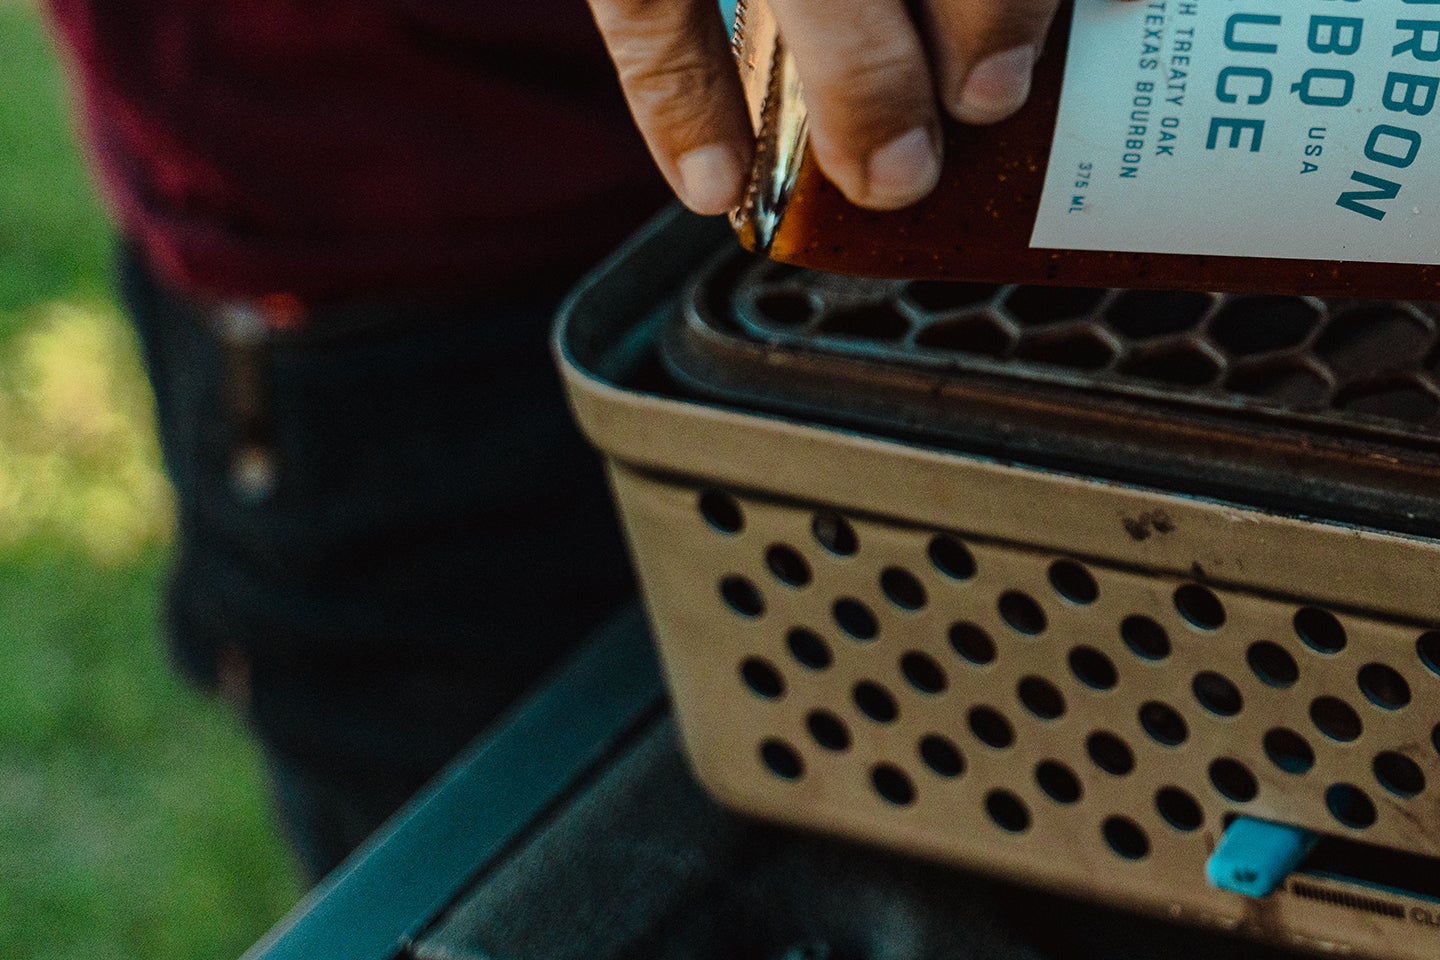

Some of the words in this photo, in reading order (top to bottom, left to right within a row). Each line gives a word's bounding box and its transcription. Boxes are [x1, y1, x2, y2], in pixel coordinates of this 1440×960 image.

[1140, 3, 1165, 69] TEXAS
[1166, 28, 1194, 106] TREATY
[1120, 82, 1154, 178] BOURBON
[1156, 118, 1179, 155] OAK
[1300, 128, 1326, 174] USA
[1075, 163, 1093, 188] 375
[1068, 195, 1085, 214] ML
